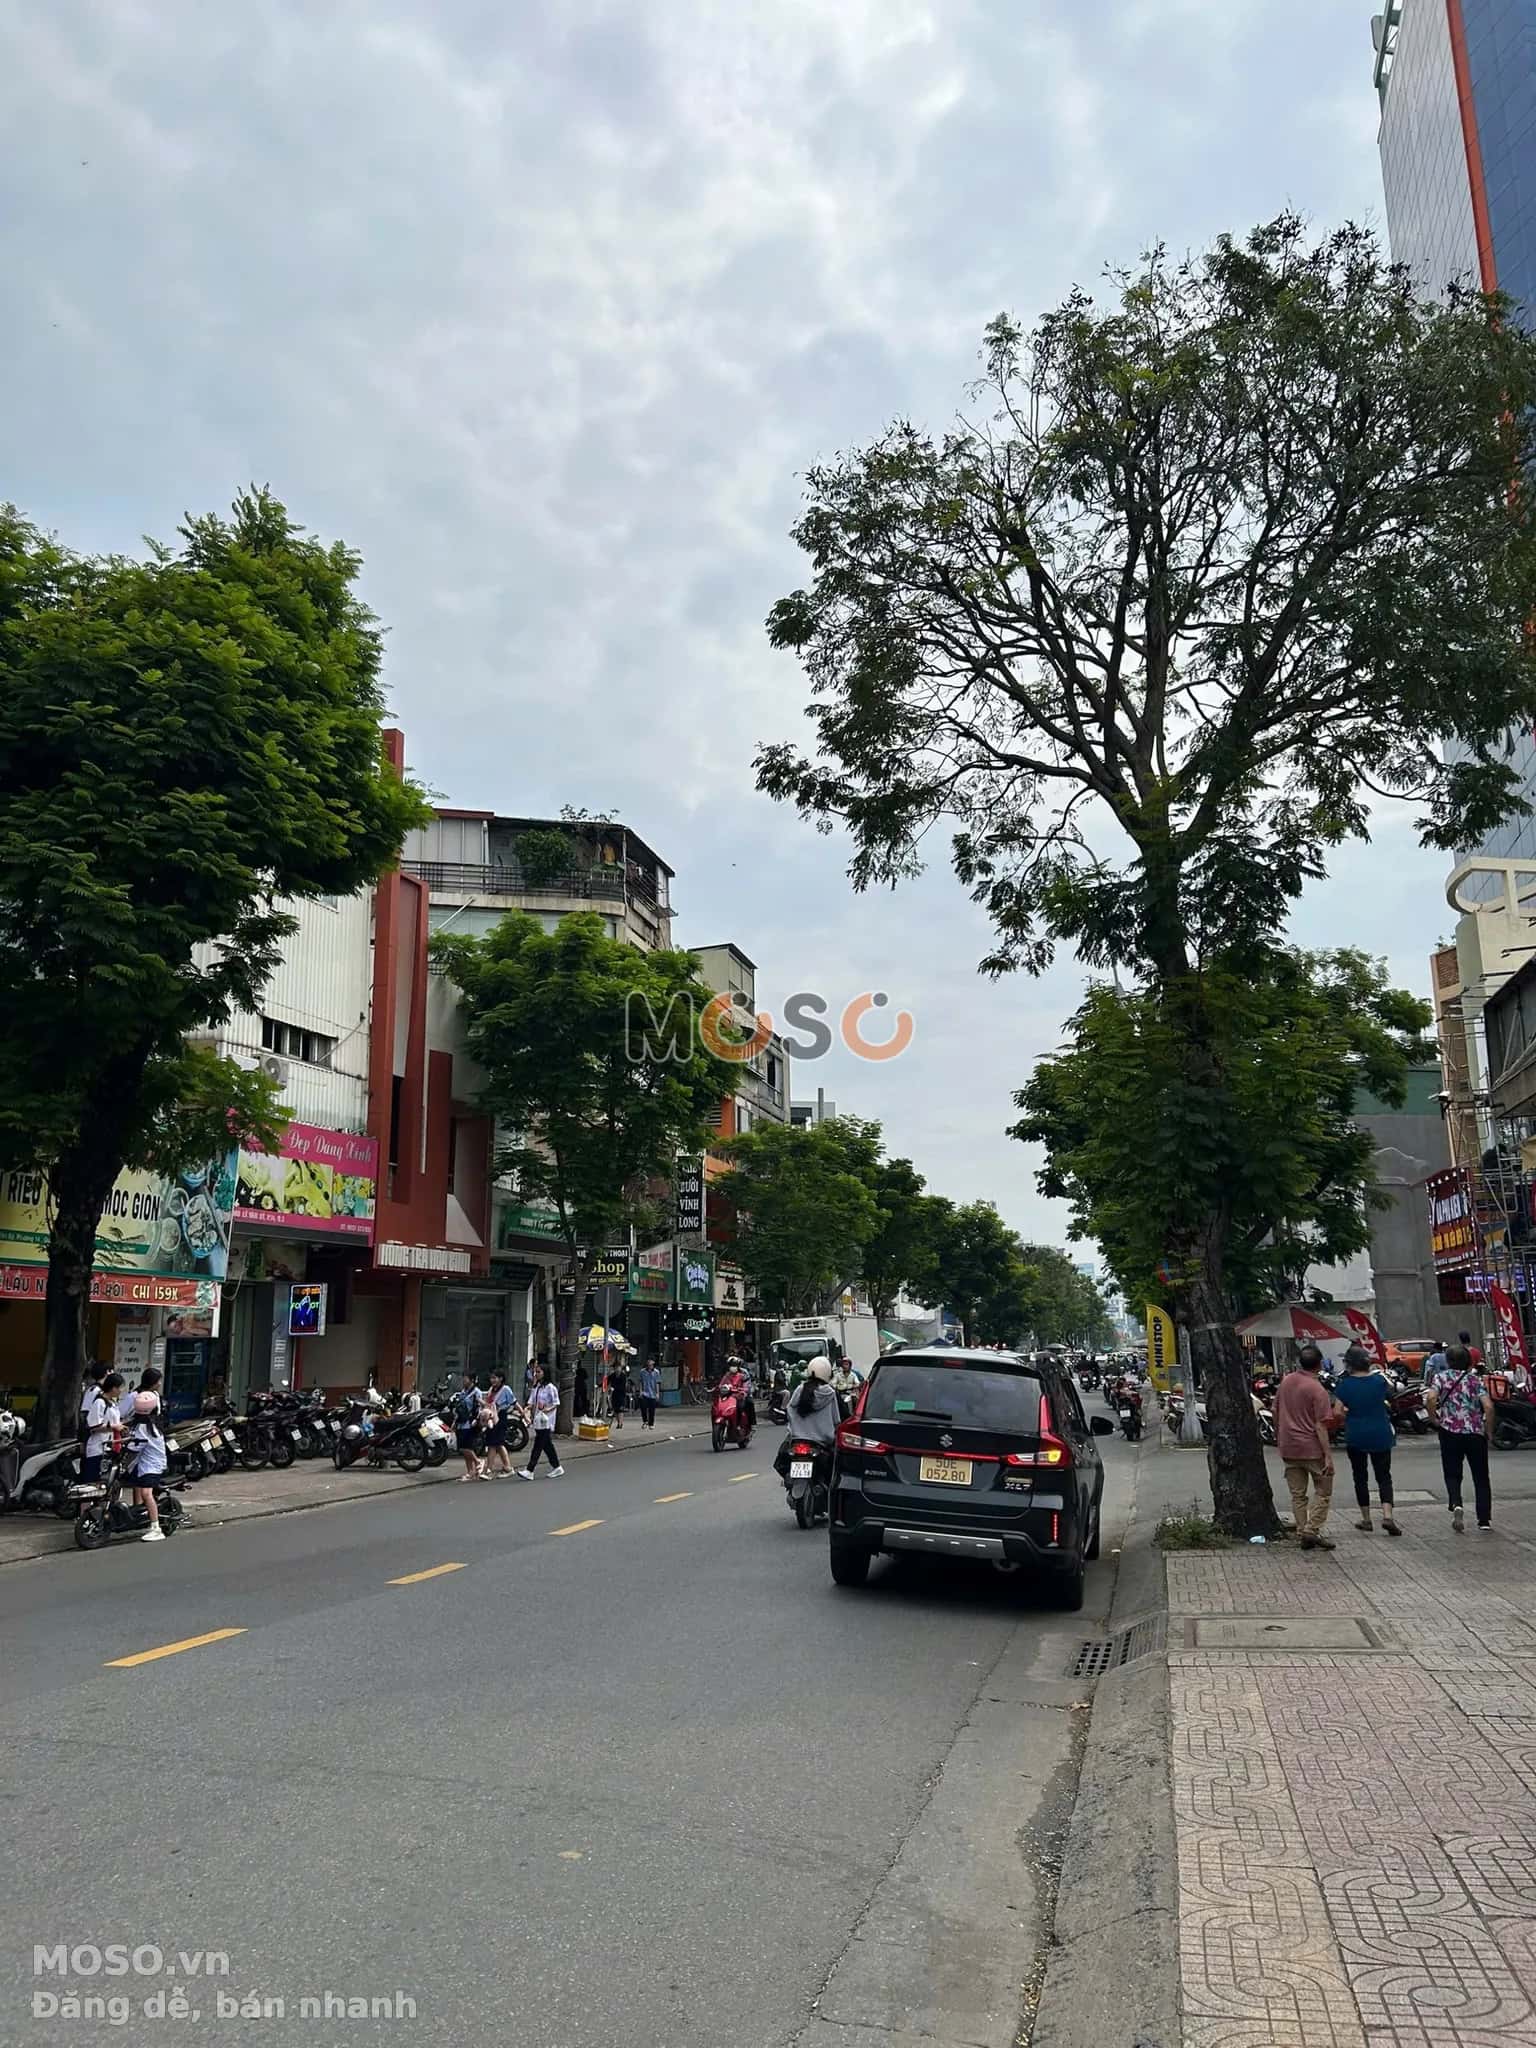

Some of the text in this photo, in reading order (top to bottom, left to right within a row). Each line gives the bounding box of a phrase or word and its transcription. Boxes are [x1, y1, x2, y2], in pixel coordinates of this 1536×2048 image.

[132, 1184, 161, 1222] GIÒN
[679, 1216, 699, 1229] LONG
[154, 1286, 179, 1301] 159K
[1153, 1316, 1164, 1369] MINISTOP
[1355, 1322, 1380, 1360] KFC
[1502, 1307, 1523, 1360] KFC
